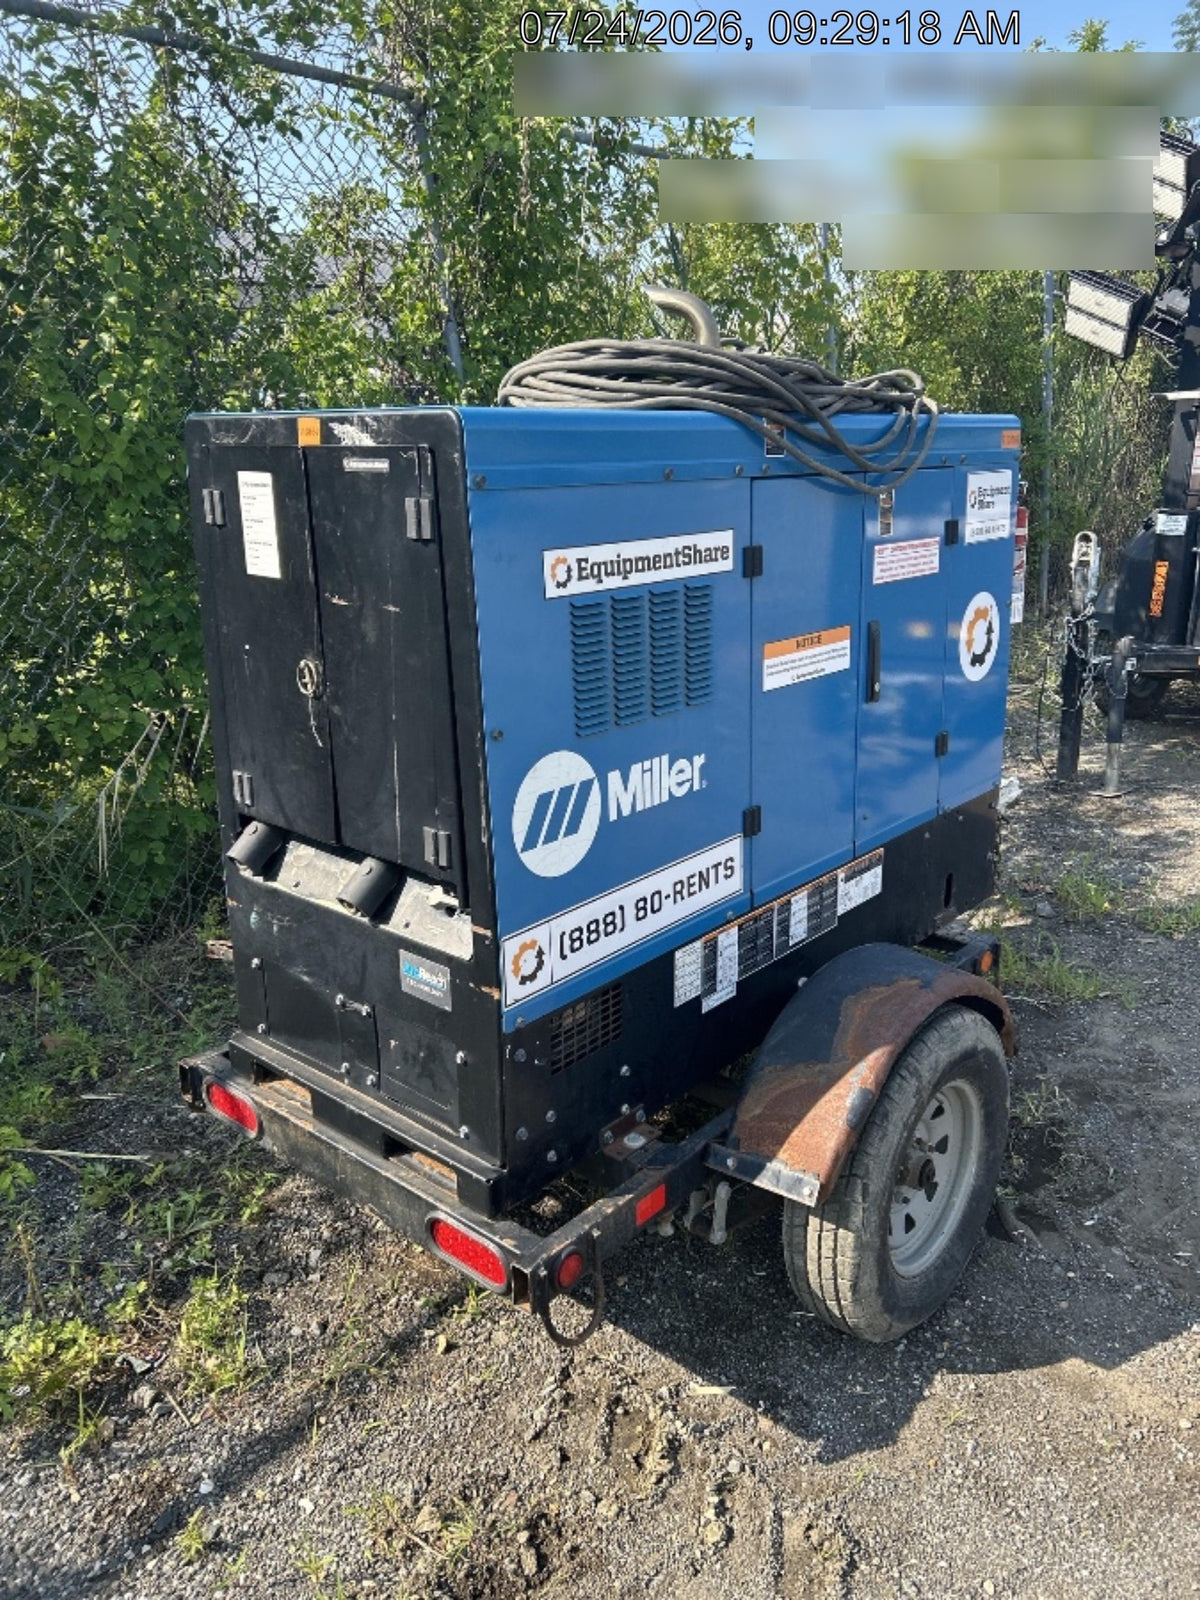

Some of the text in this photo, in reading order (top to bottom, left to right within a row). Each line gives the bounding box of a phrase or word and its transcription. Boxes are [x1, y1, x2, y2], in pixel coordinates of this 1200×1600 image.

[576, 544, 730, 584] EquipmentShare
[796, 635, 822, 649] NOTICE
[607, 753, 706, 823] Miller
[559, 904, 626, 960] (888)
[634, 856, 735, 922] 80-RENTS
